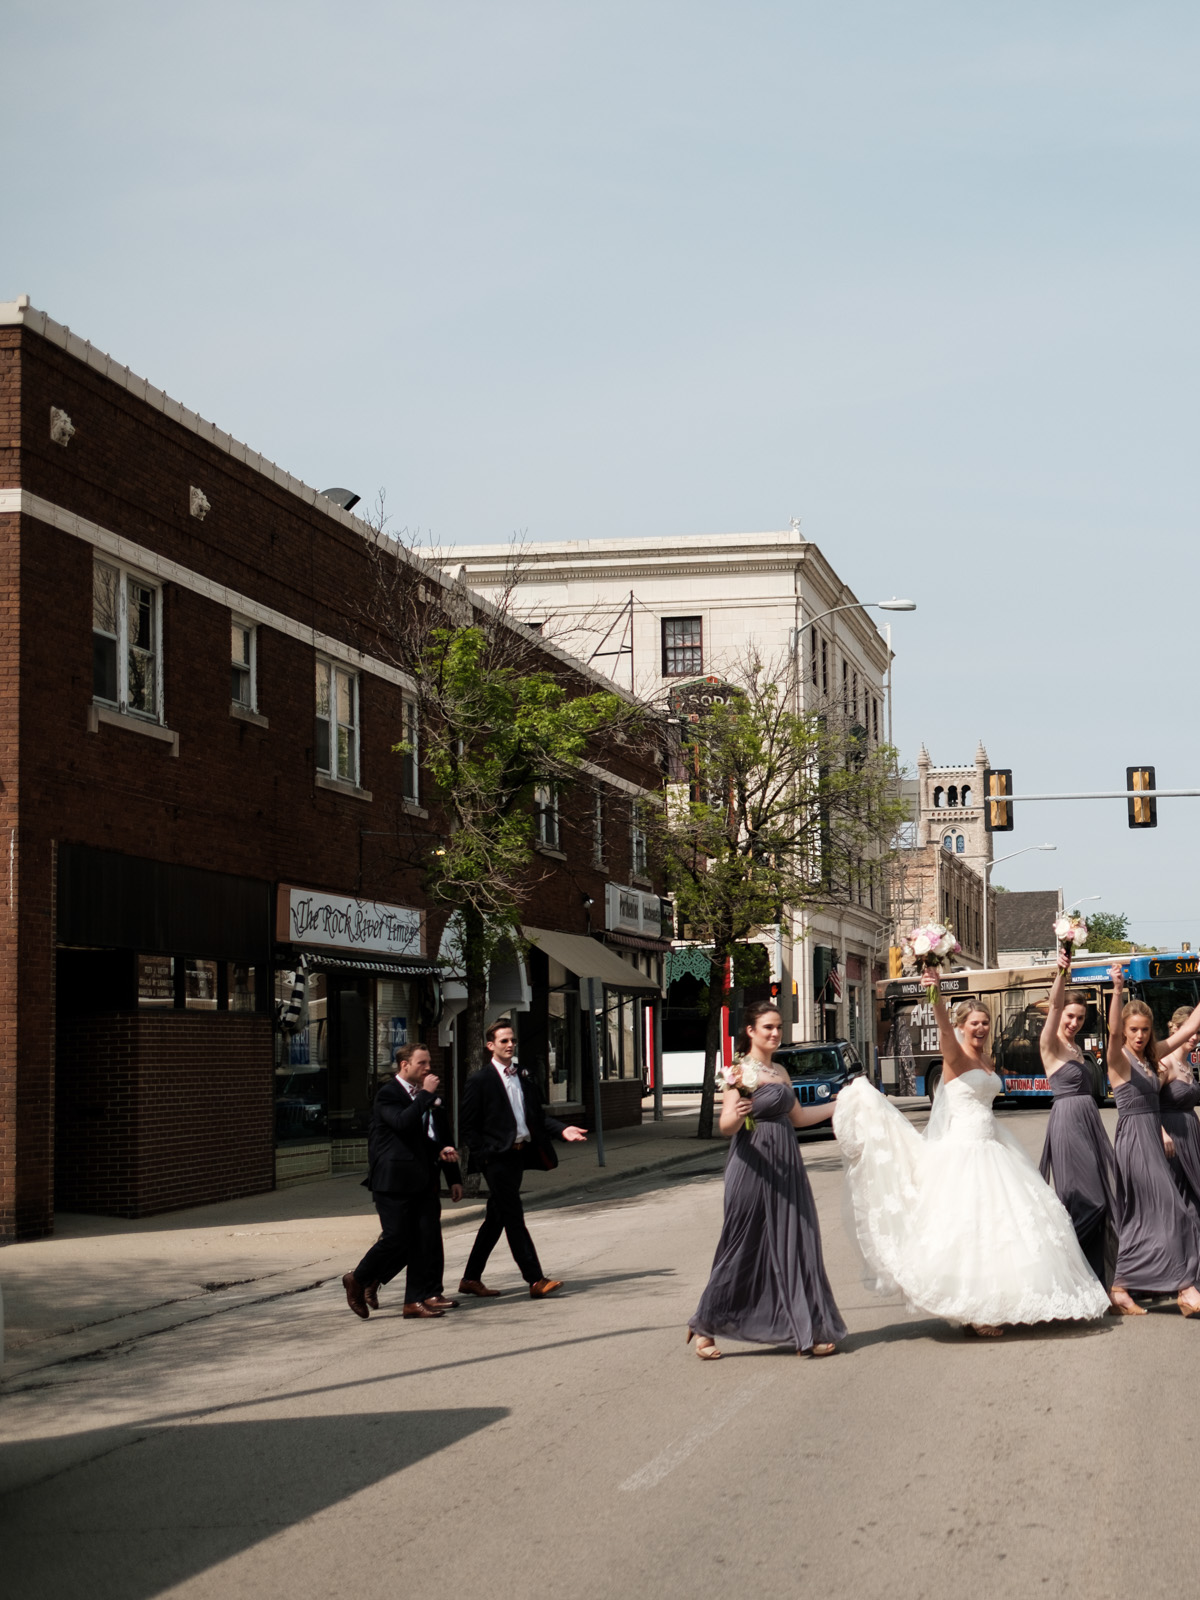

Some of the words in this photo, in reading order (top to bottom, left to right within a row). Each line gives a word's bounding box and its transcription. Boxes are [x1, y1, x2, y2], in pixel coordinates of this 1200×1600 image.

[688, 694, 736, 706] SODA
[291, 898, 319, 938] The
[1154, 962, 1160, 976] 7
[902, 984, 918, 994] WHEN
[940, 980, 959, 991] STRIKES
[1005, 1078, 1033, 1091] NATIONAL
[1034, 1078, 1052, 1091] GUAR
